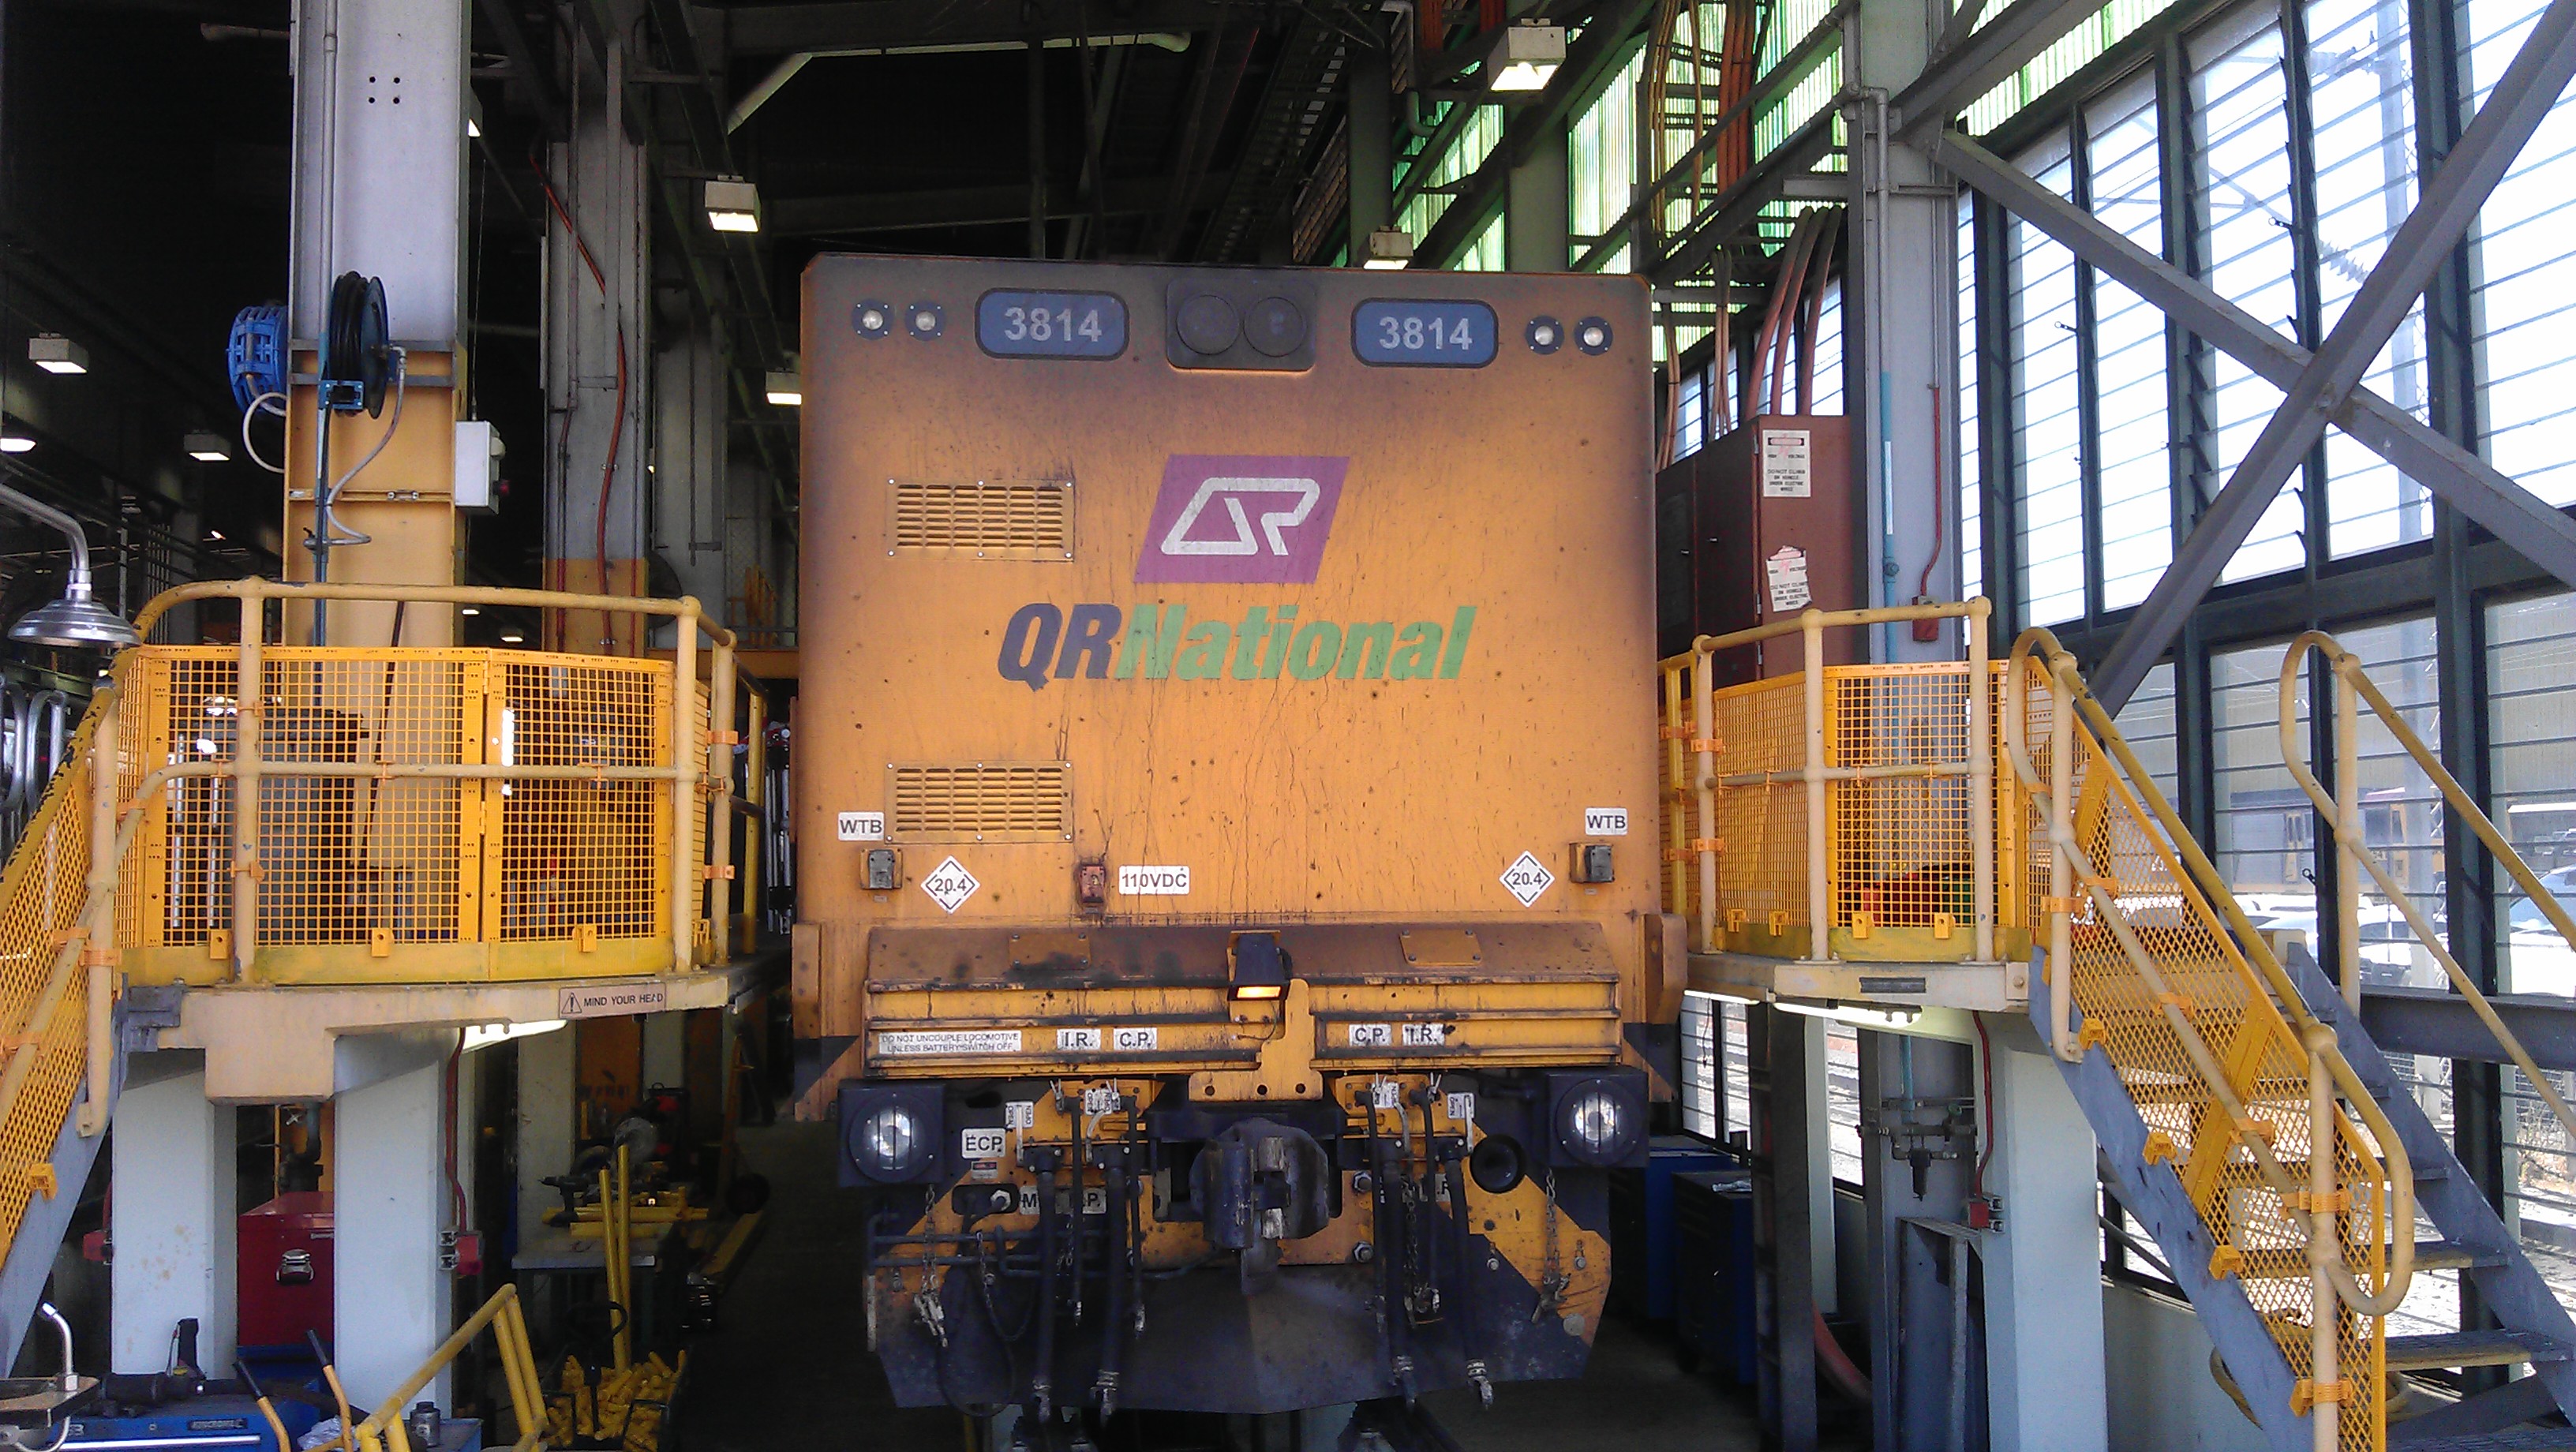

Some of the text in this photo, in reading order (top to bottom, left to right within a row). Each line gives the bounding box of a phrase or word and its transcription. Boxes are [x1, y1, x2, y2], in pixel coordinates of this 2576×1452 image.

[1003, 306, 1103, 342] 3814
[1378, 316, 1473, 351] 3814
[840, 818, 882, 835] WTB
[1586, 814, 1627, 830] WTB
[934, 878, 968, 893] 20.4
[1121, 873, 1187, 889] 110VDC
[1511, 871, 1543, 886] 20.4
[583, 993, 664, 1007] MIND YOUR HEAD
[916, 1034, 962, 1042] UNCOUPLE
[964, 1032, 1019, 1042] LOCOMOTIVE
[1064, 1031, 1094, 1047] I.R.
[1119, 1031, 1152, 1048] C.P.
[1354, 1027, 1386, 1042] C.P.
[887, 1043, 921, 1053] UNLESS
[922, 1043, 960, 1052] BATTERY
[962, 1042, 994, 1051] SWITCH
